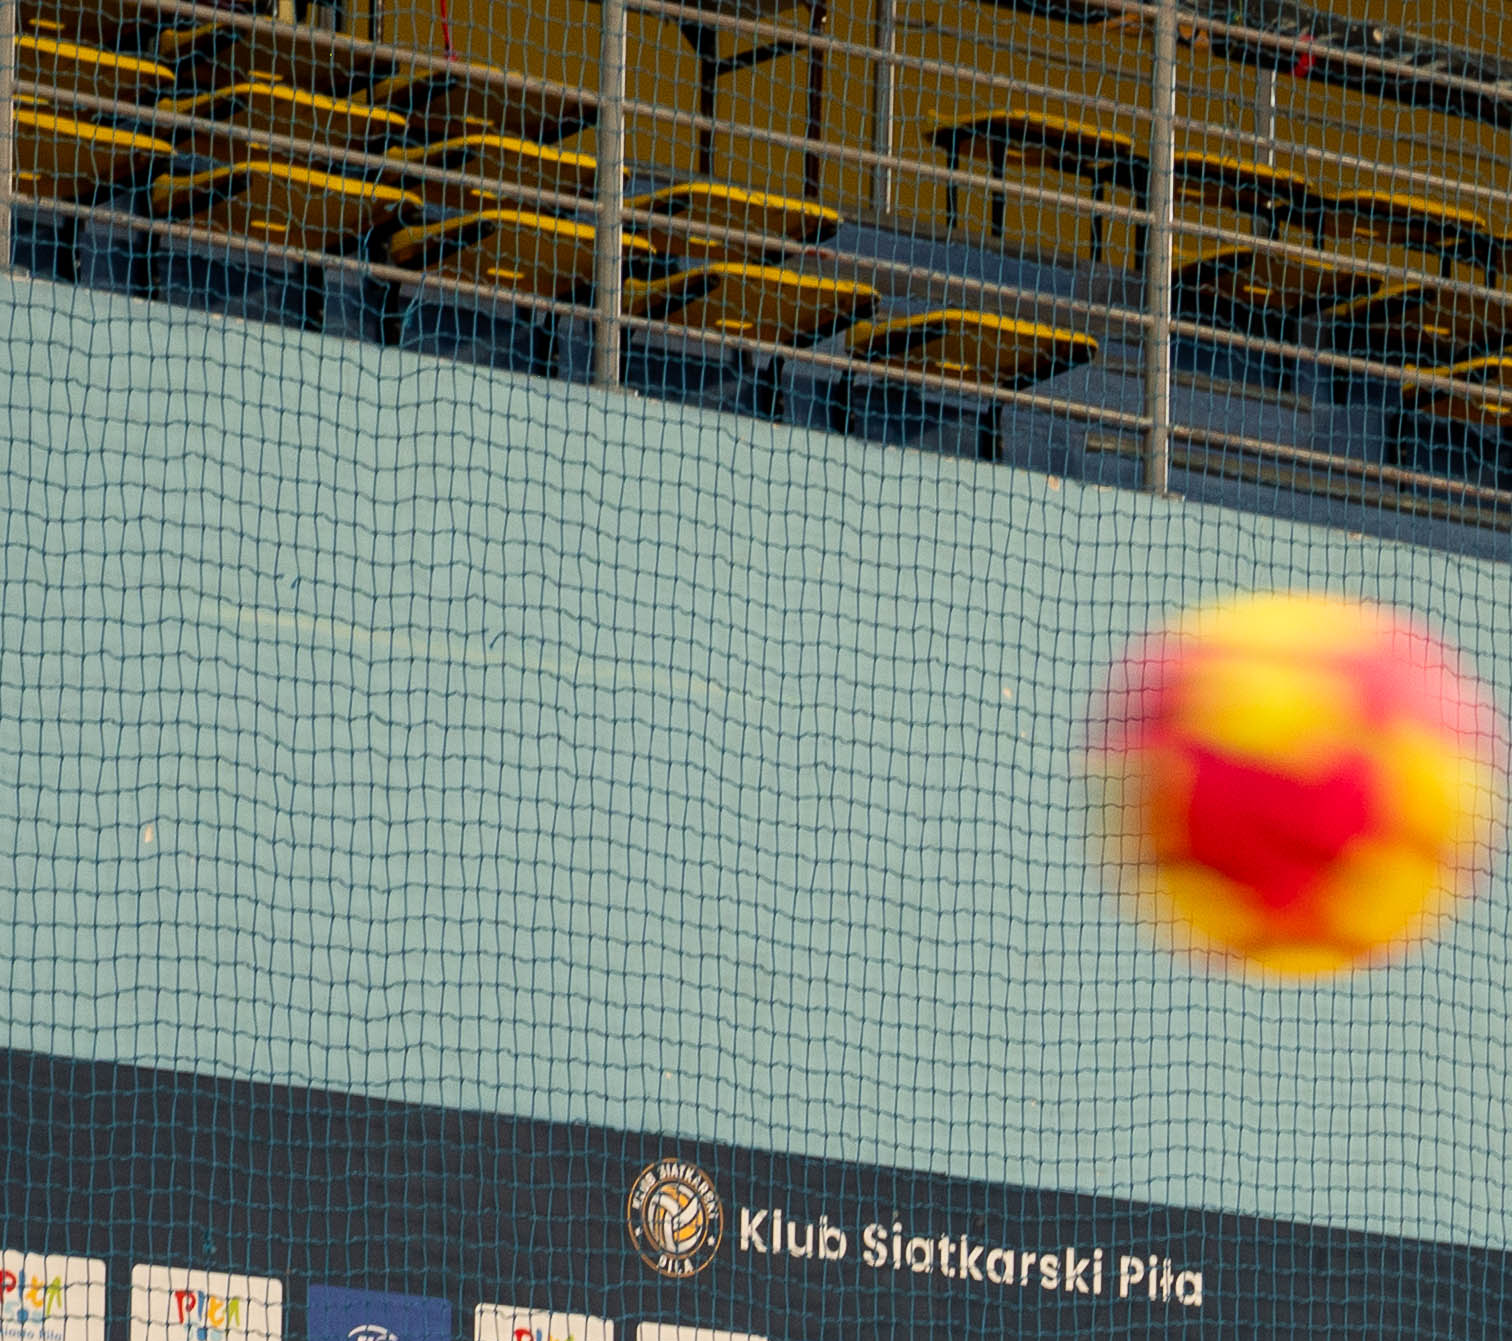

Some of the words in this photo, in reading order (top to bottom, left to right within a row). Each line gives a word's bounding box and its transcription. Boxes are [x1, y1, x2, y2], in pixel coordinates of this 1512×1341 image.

[740, 1207, 848, 1261] Klub
[862, 1220, 1104, 1296] Siatkarski
[1118, 1254, 1204, 1307] Piła
